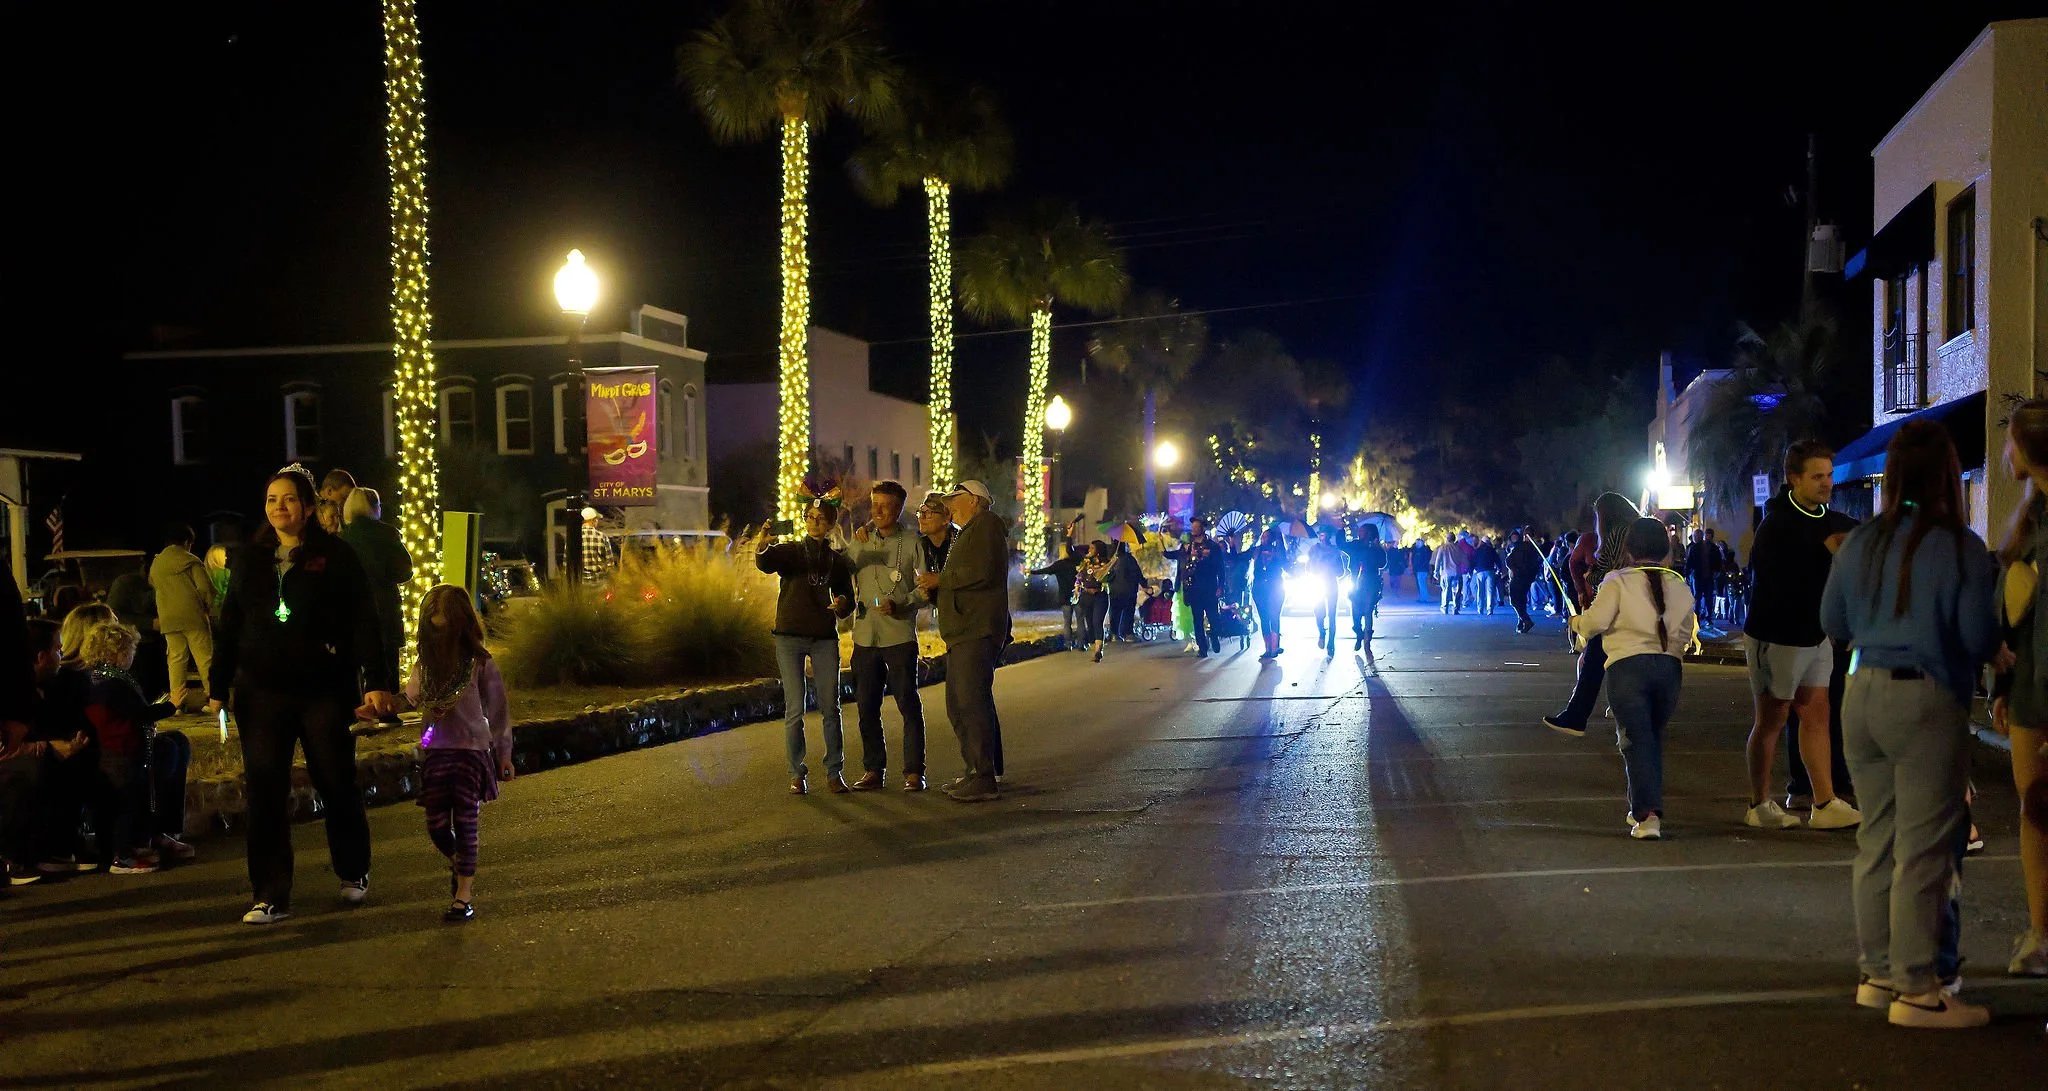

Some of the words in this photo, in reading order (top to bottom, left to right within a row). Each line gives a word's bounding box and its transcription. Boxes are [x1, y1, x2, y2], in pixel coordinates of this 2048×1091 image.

[622, 383, 651, 397] GRAS
[594, 488, 609, 498] ST.
[613, 487, 653, 497] MARYS
